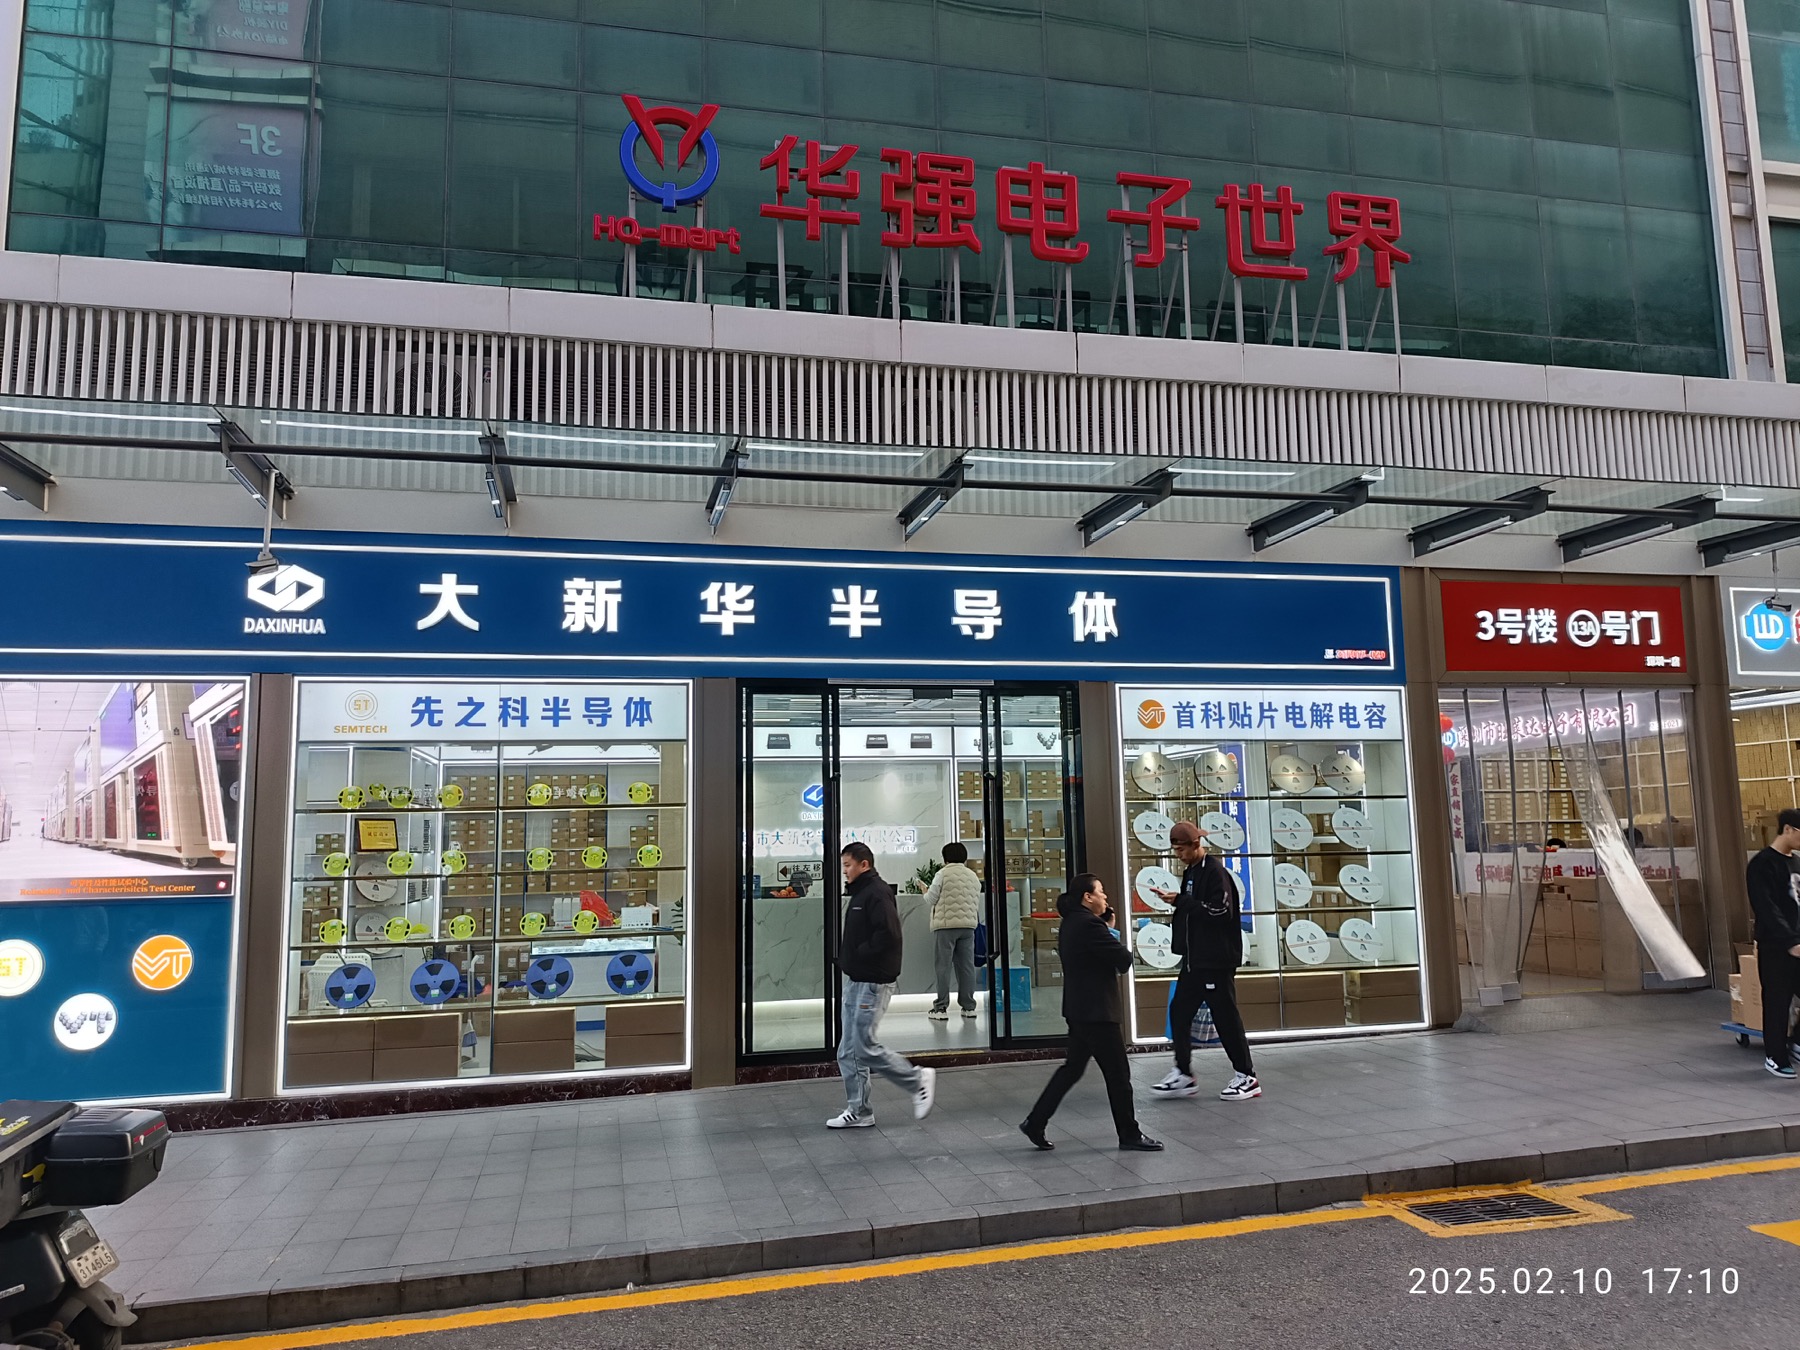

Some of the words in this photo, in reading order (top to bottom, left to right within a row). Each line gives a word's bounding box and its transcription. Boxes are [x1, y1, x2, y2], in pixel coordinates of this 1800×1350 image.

[760, 134, 1411, 288] 华强电子世界
[593, 213, 741, 255] HQ-mart
[416, 572, 1119, 643] 大新华半导体
[243, 617, 327, 635] DAXINHUA
[1475, 608, 1558, 645] 3号楼
[410, 696, 653, 728] 先之科半导体
[1172, 700, 1388, 730] 首科贴片电解电容
[333, 725, 388, 734] SEMTECH
[792, 864, 821, 872] 往左移
[150, 884, 167, 892] Test
[168, 884, 196, 892] Center
